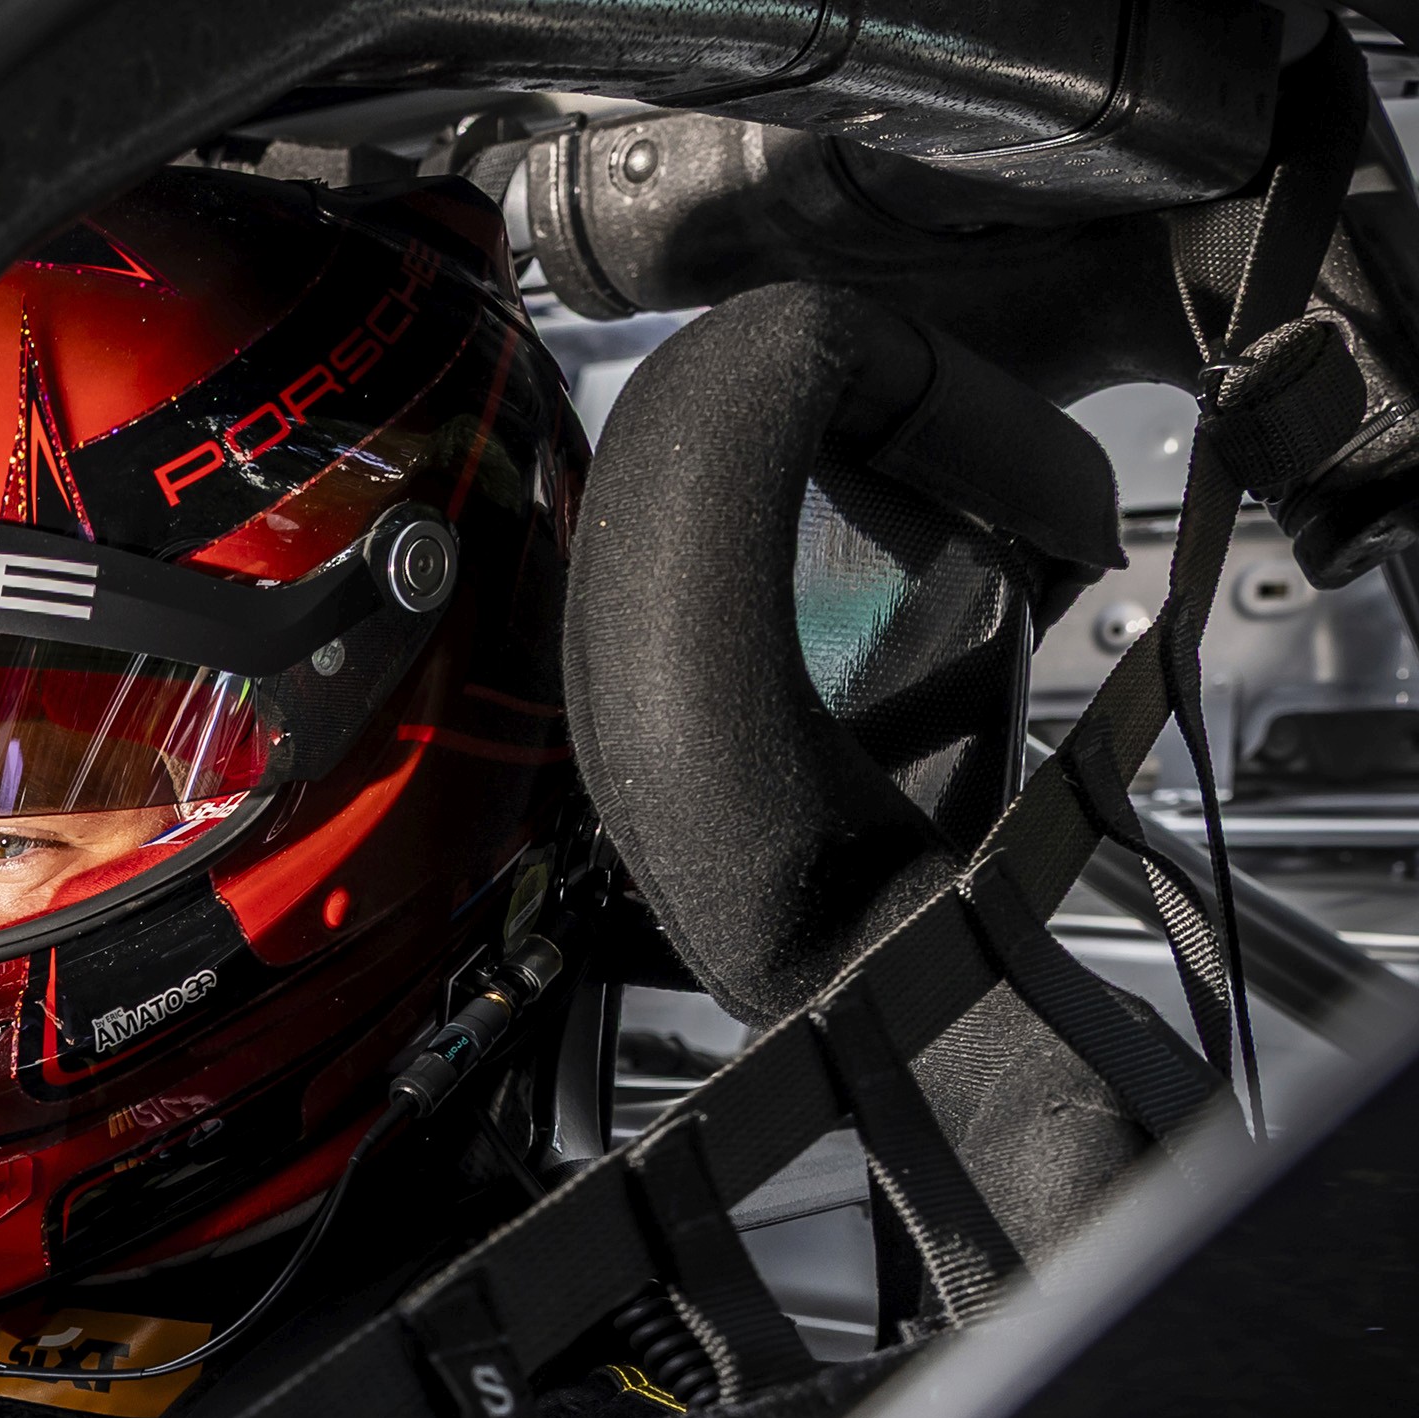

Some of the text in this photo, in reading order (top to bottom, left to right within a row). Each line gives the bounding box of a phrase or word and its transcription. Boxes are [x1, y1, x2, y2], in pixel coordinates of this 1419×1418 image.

[152, 237, 442, 508] PORSCHE
[97, 989, 183, 1051] AMATO
[105, 1008, 124, 1024] ERIC
